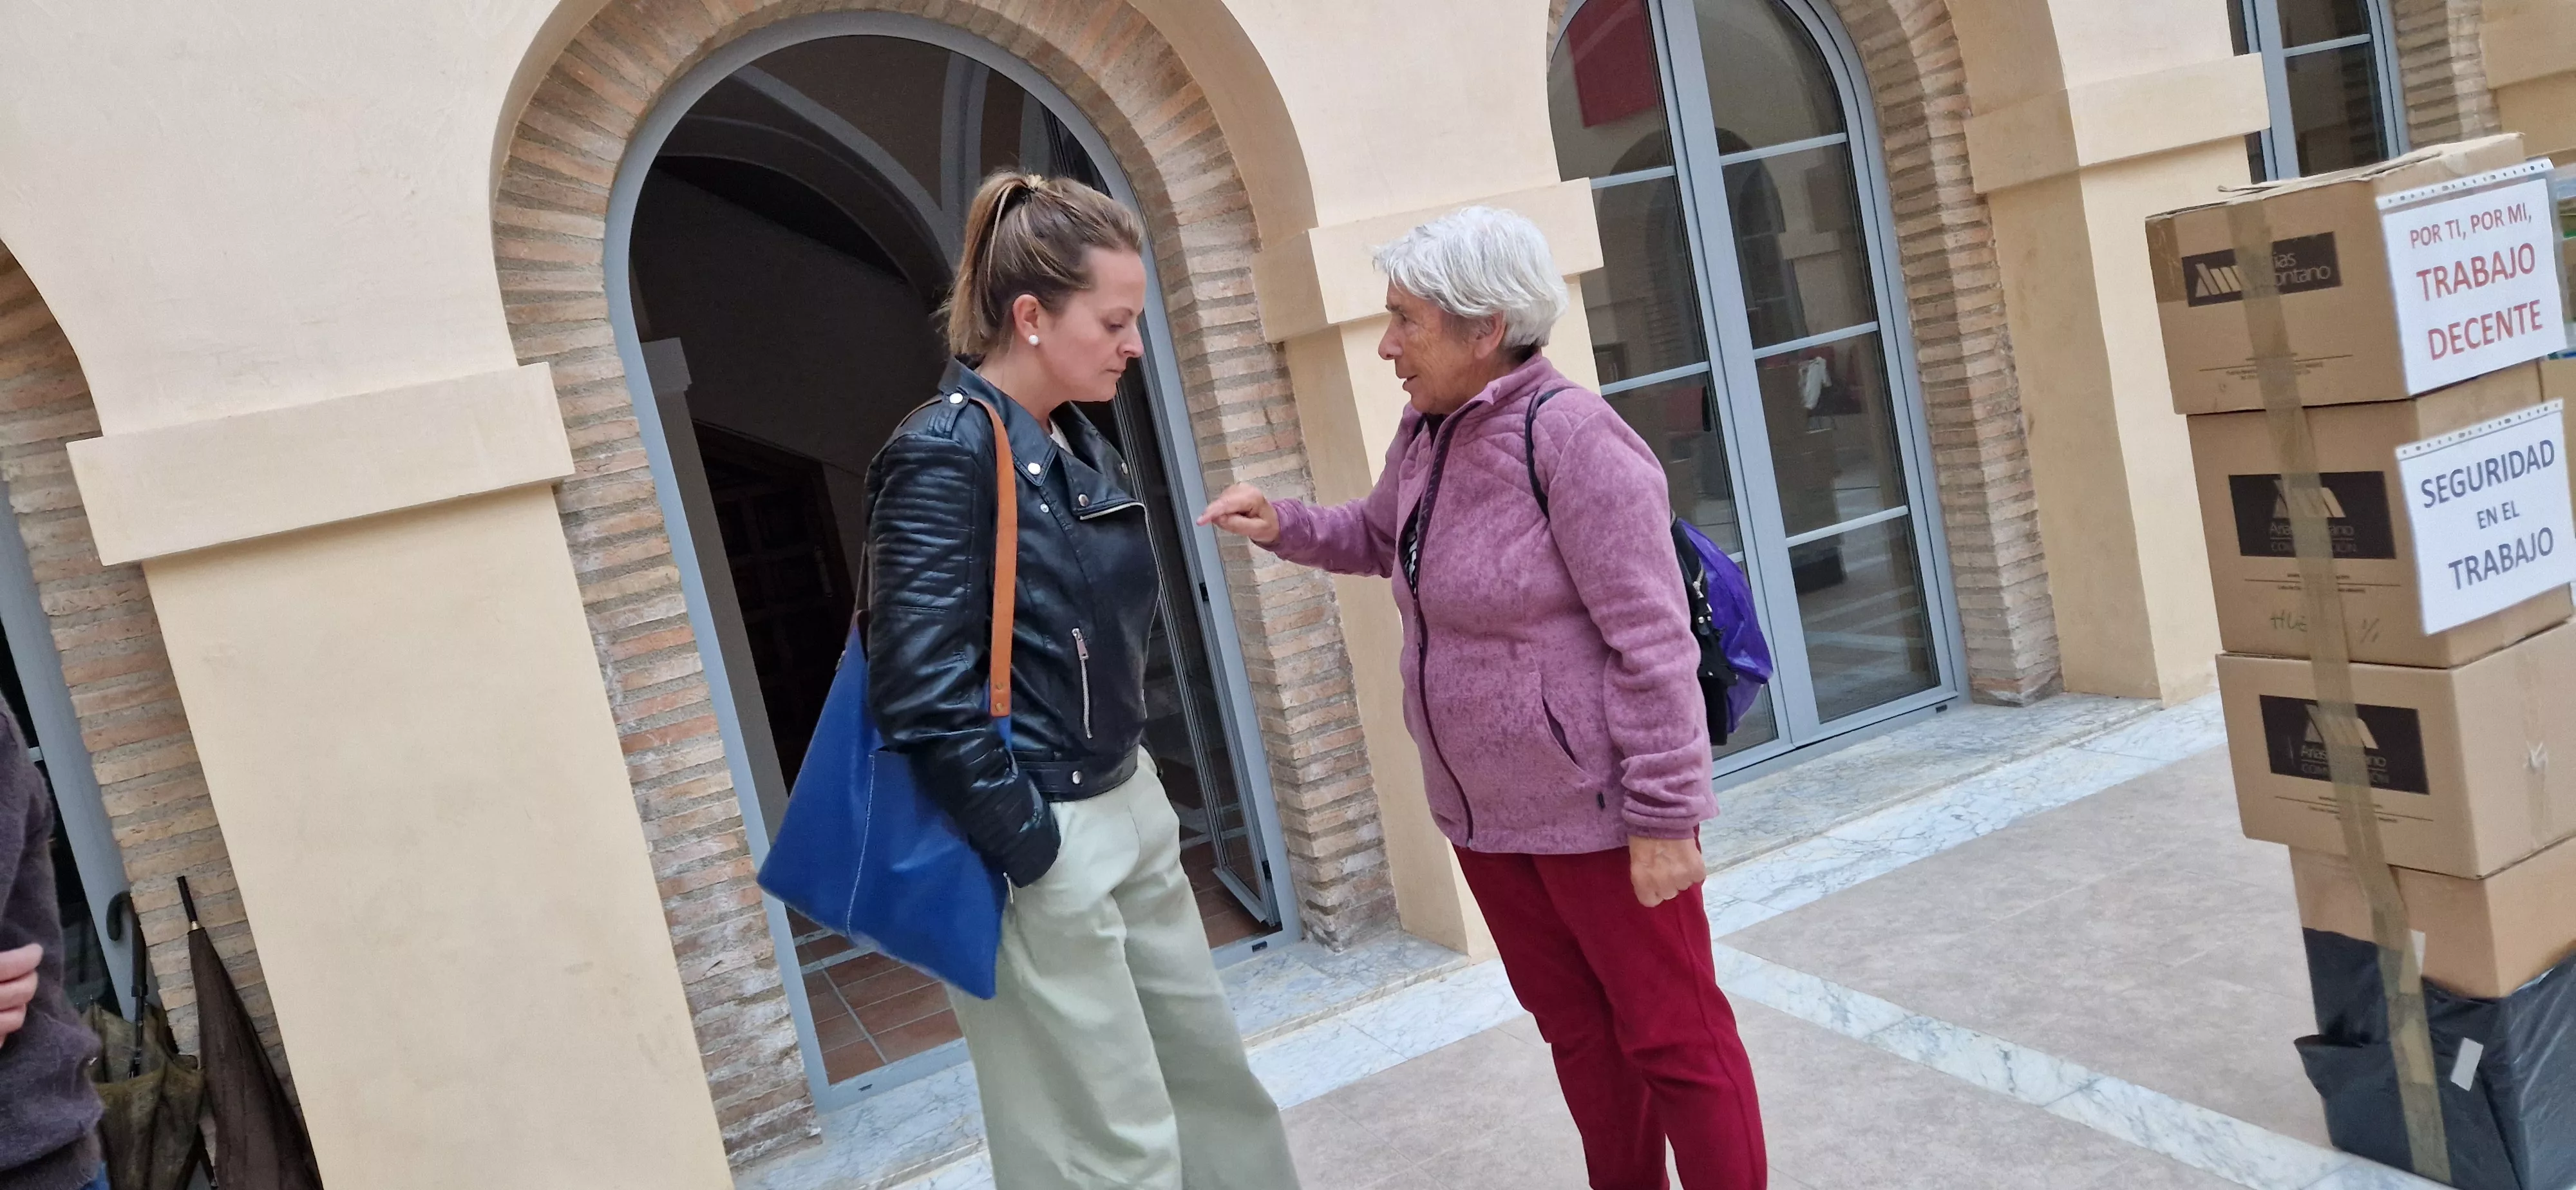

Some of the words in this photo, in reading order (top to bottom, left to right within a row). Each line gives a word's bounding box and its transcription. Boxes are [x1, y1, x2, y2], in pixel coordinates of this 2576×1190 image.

[2409, 223, 2443, 249] POR
[2445, 218, 2467, 241] TI,
[2470, 209, 2505, 234] POR
[2507, 202, 2532, 225] MI,
[2274, 265, 2331, 287] ontano
[2416, 242, 2535, 301] TRABAJO
[2428, 299, 2543, 361] DECENTE
[2420, 439, 2555, 509] SEGURIDAD
[2476, 506, 2499, 530] EN
[2501, 500, 2520, 521] EL
[2448, 527, 2554, 590] TRABAJO
